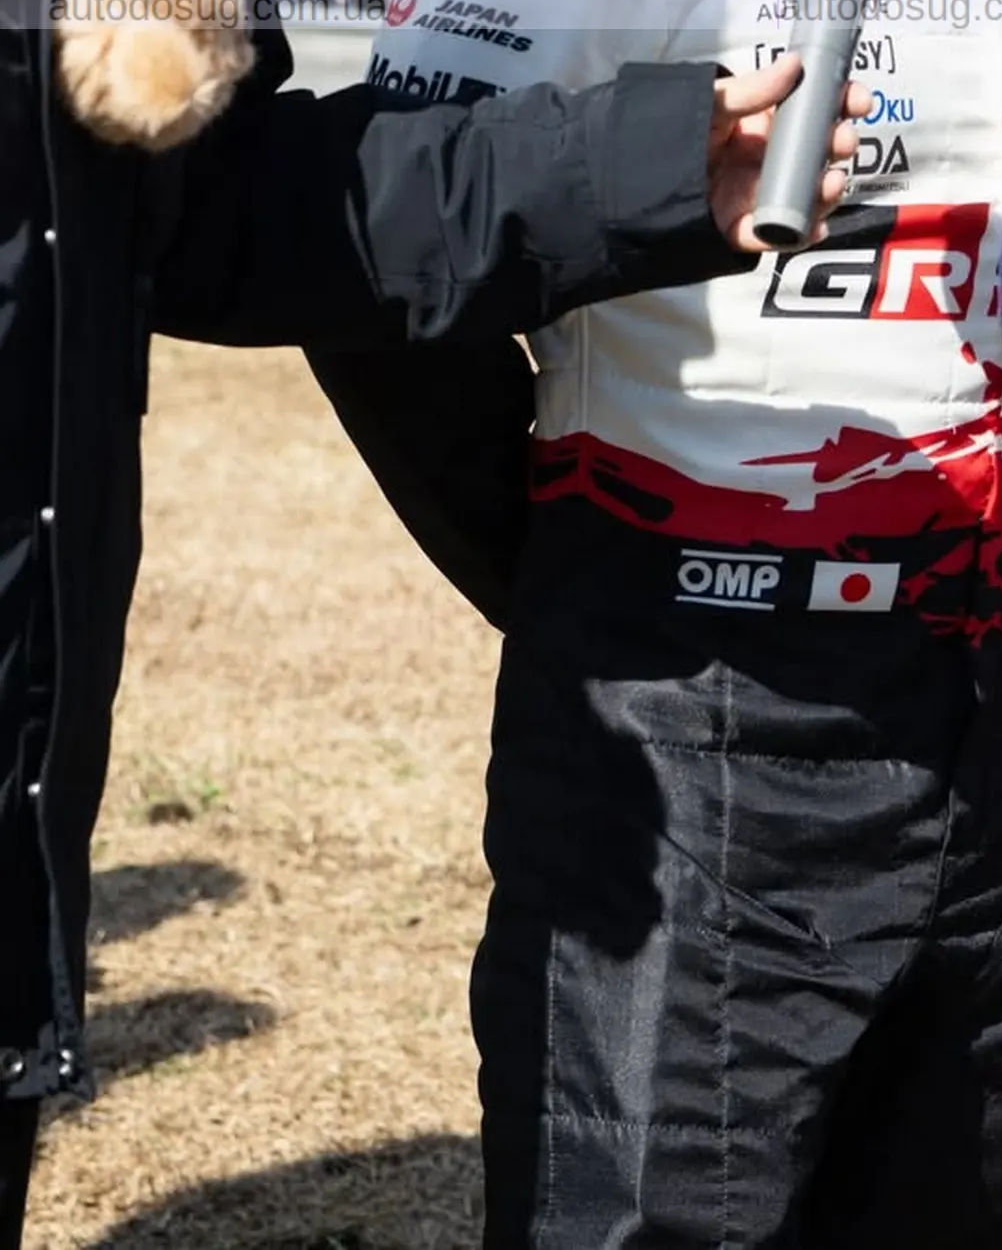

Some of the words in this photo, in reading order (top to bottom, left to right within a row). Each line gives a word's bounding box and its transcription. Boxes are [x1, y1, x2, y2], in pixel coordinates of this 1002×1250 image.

[412, 13, 534, 52] AIRLINES
[366, 53, 453, 100] Mobil
[774, 248, 972, 313] GR
[678, 559, 780, 600] OMP
